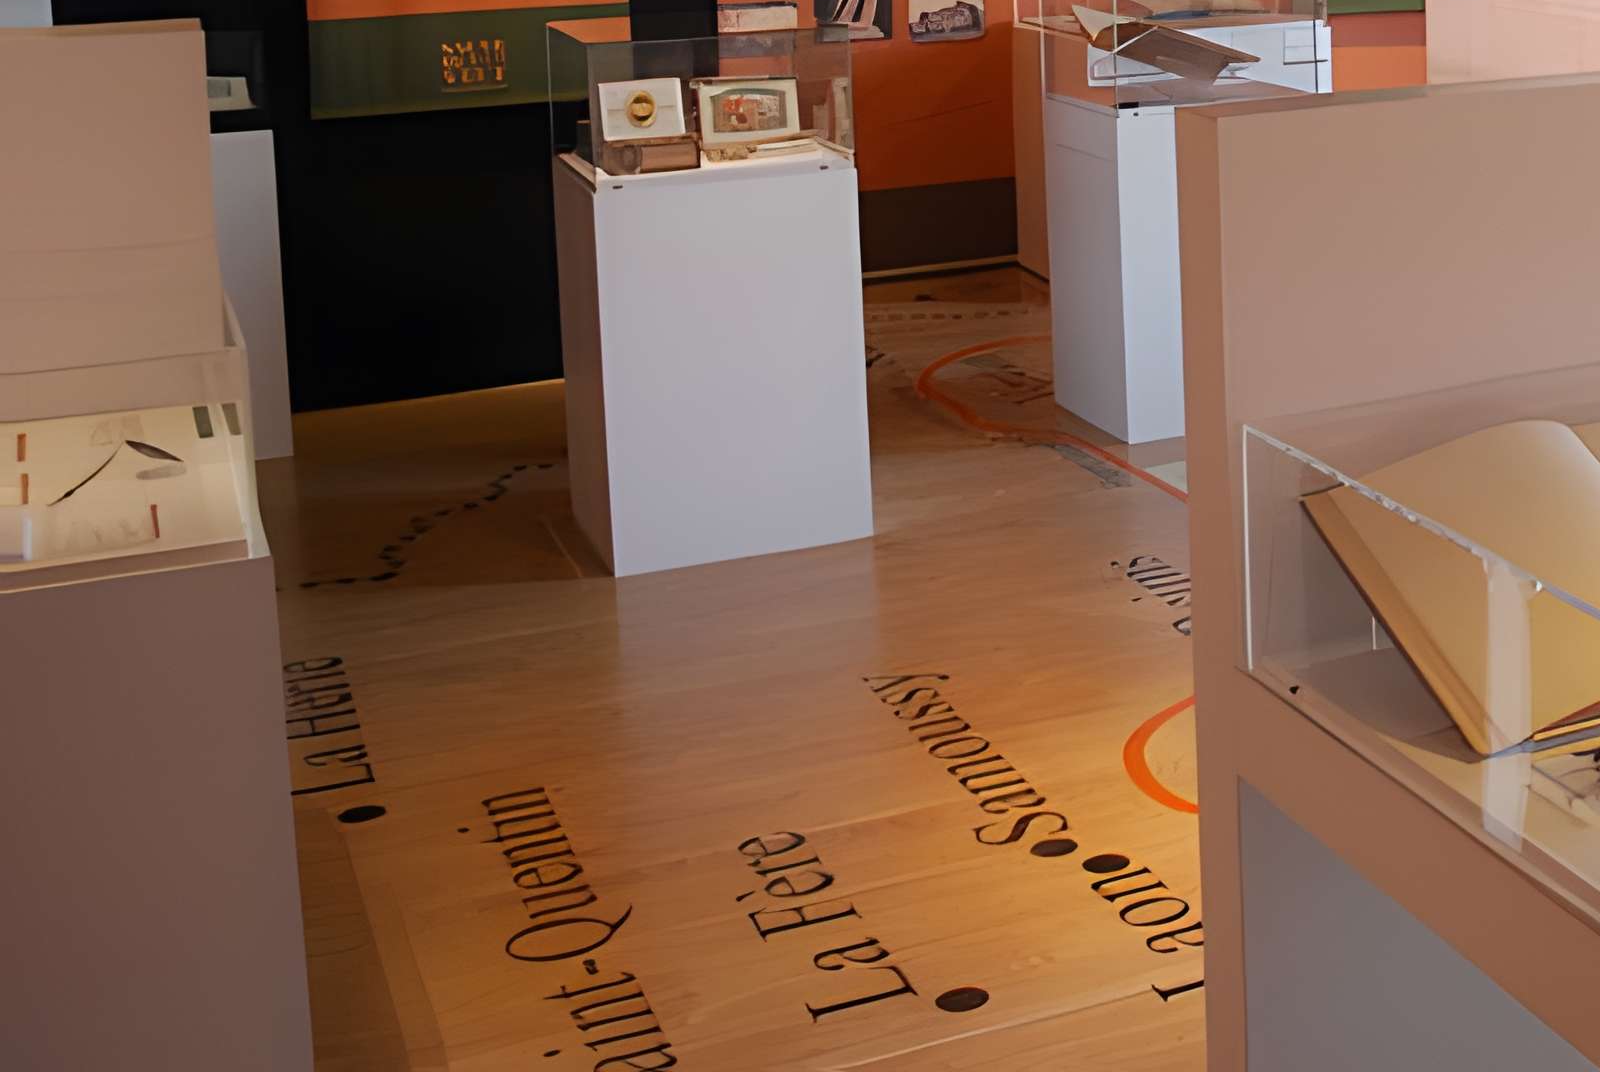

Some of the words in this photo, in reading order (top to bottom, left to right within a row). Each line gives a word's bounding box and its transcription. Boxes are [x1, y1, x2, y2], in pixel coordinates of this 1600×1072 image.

[291, 744, 375, 796] La
[862, 673, 1069, 845] Samoussy
[457, 787, 677, 1072] aint-Quentin
[736, 832, 862, 942] Fère
[806, 937, 918, 1023] La
